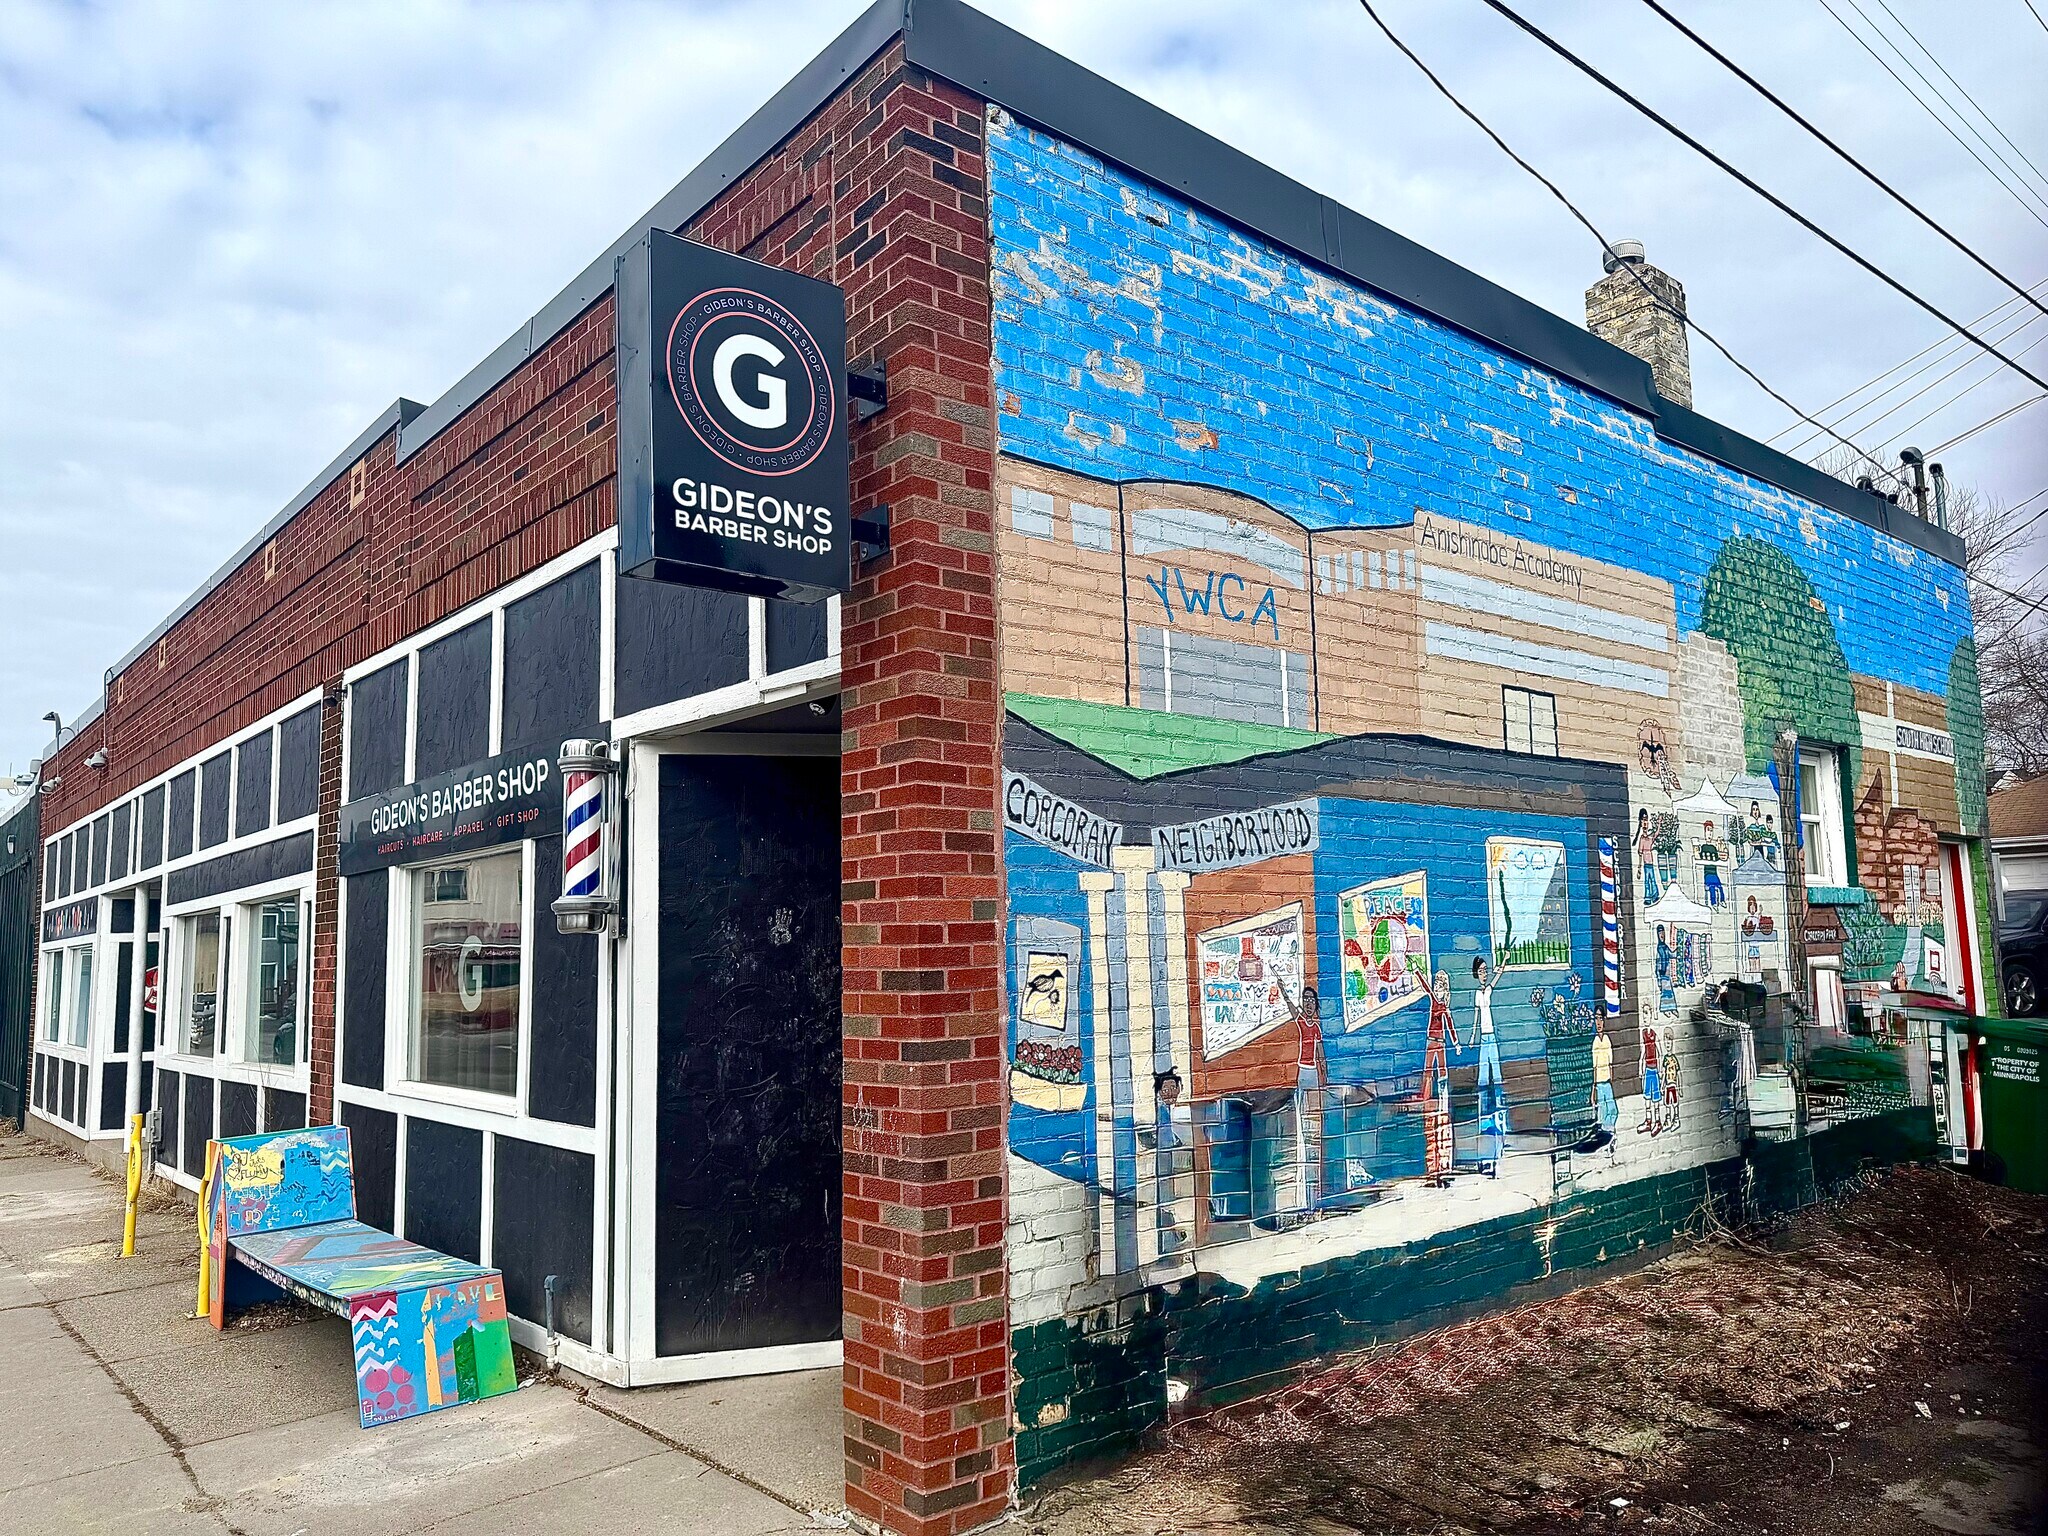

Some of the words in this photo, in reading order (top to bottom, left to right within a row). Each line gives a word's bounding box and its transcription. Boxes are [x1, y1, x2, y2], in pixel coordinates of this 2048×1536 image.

[679, 316, 697, 347] SHOP
[703, 297, 754, 314] GIDEON'S
[757, 303, 800, 339] BARBER
[799, 338, 821, 372] SHOP
[676, 349, 693, 401] BARBER
[712, 334, 787, 429] G
[689, 404, 735, 454] GIDEON'S
[813, 384, 828, 438] GIDEON'S
[746, 456, 778, 467] SHOP
[781, 437, 816, 466] BARBER
[672, 477, 833, 536] GIDEON'S
[675, 508, 768, 544] BARBER
[773, 529, 832, 556] SHOP
[1513, 540, 1582, 600] Academy
[1146, 566, 1279, 640] YWCA
[1897, 727, 1919, 749] SOUTH
[371, 793, 428, 835] GIDEON'S
[431, 774, 494, 819] BARBER
[497, 758, 549, 801] SHOP
[378, 839, 403, 855] HAIRCUTS
[412, 830, 443, 846] HAIRCARE
[453, 820, 484, 836] APPAREL
[497, 813, 515, 828] GIFT
[517, 807, 540, 823] SHOP
[1006, 778, 1118, 869] CORCORAN
[1158, 807, 1311, 868] NEIGHBORHOOD
[1364, 896, 1412, 922] PEACE
[459, 935, 482, 1012] G
[1617, 923, 1628, 999] BARBER
[1993, 1070, 2040, 1082] MINNEAPOLIS
[1996, 1063, 2009, 1071] THE
[2010, 1065, 2025, 1073] CITY
